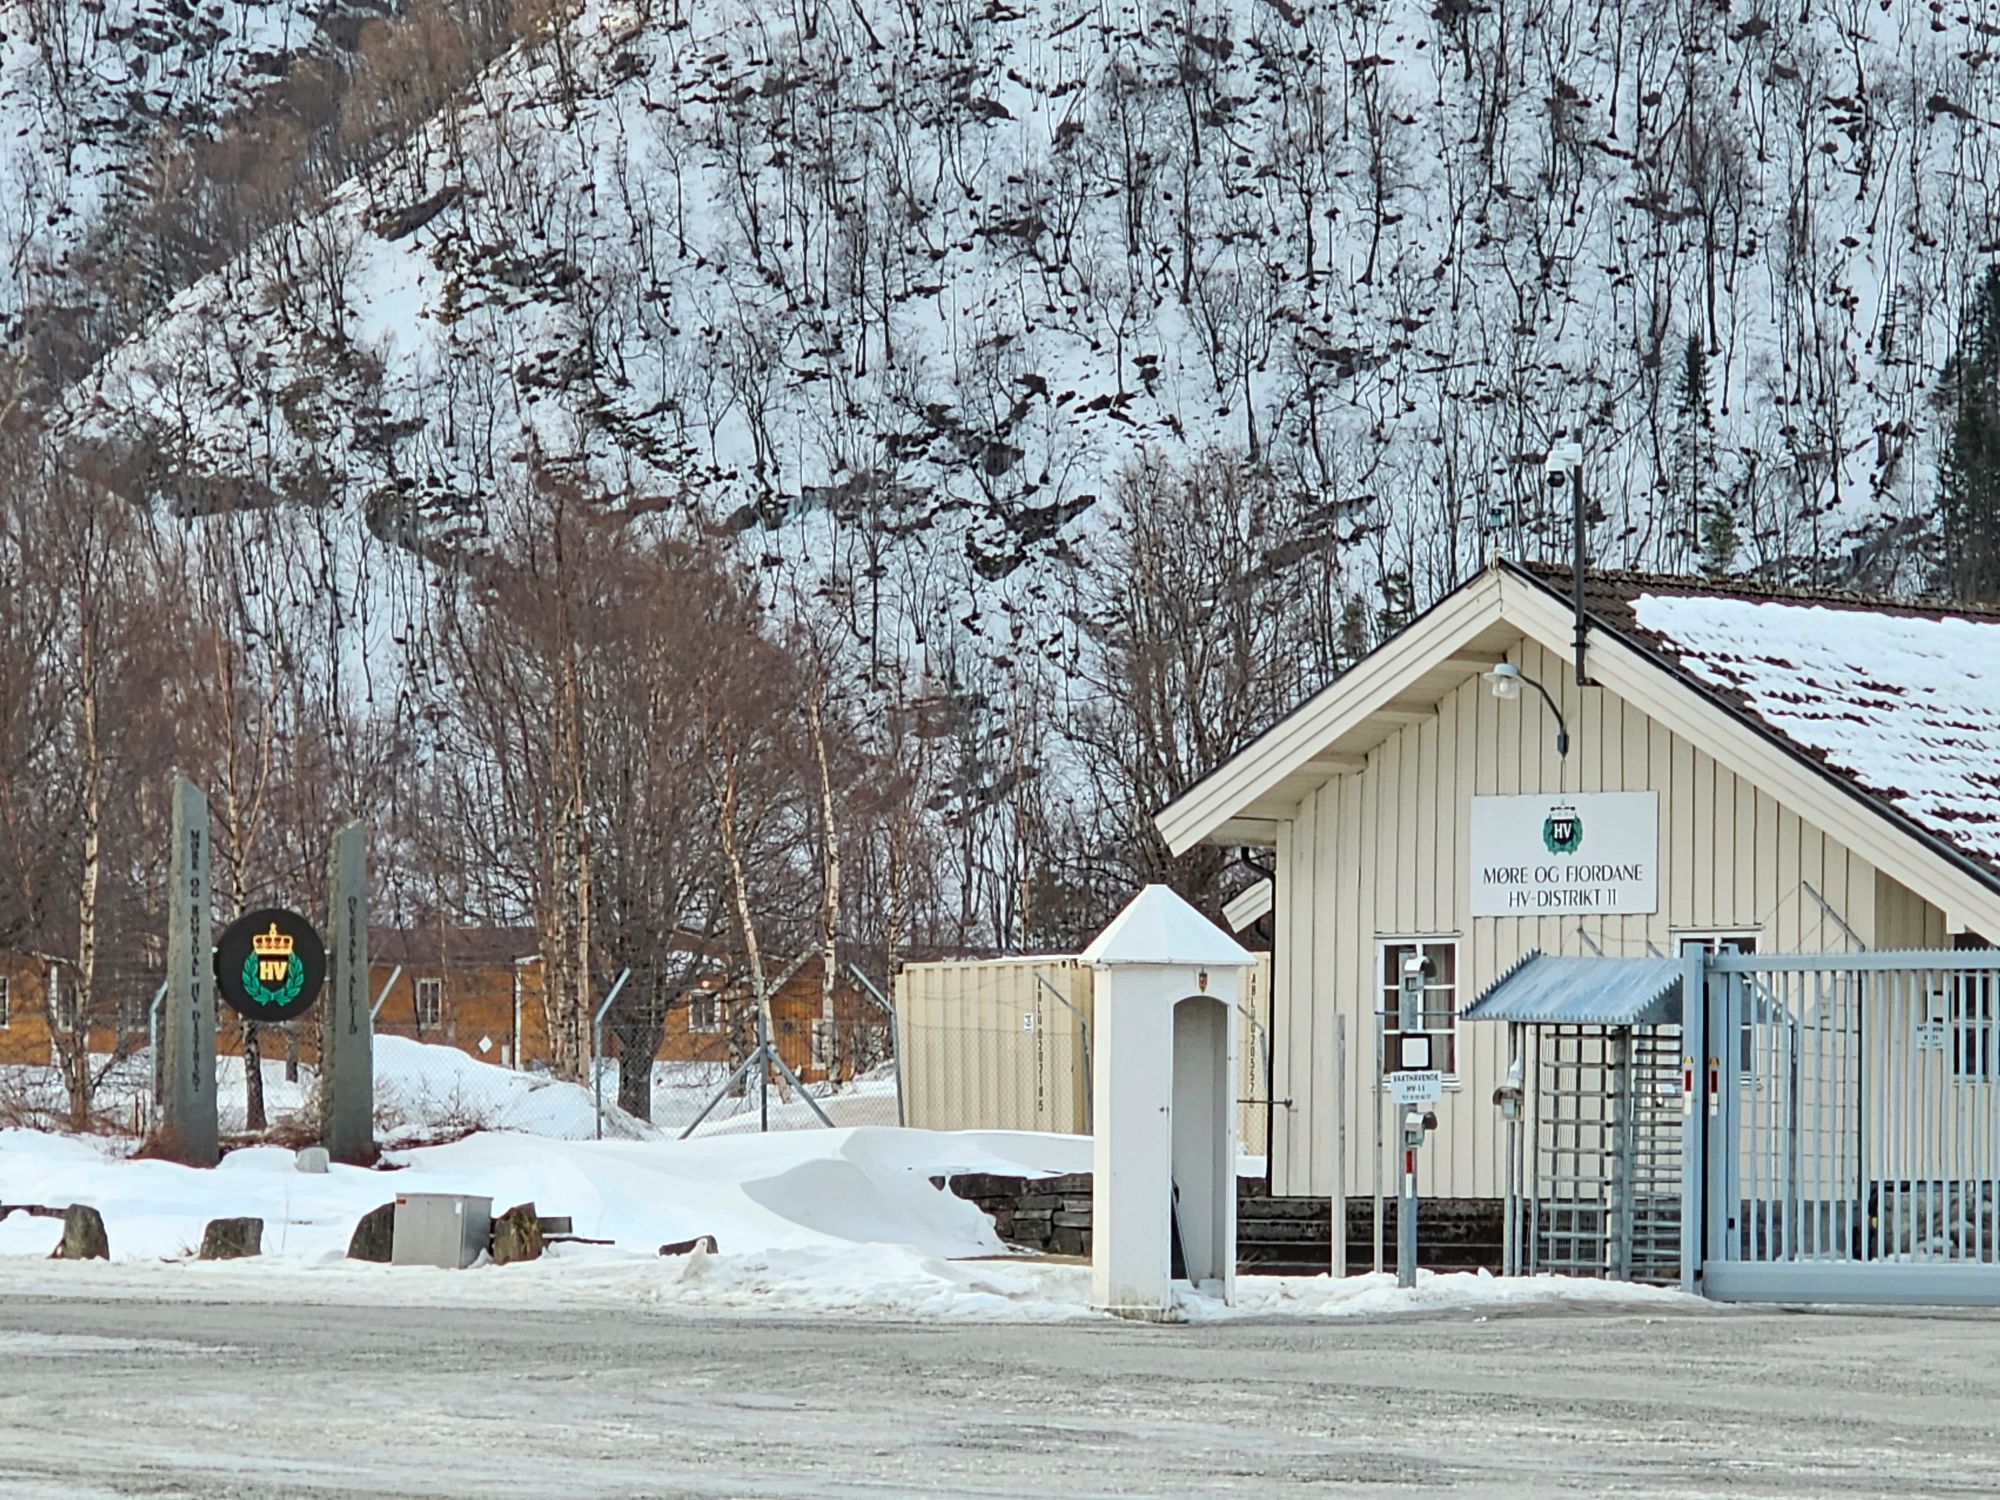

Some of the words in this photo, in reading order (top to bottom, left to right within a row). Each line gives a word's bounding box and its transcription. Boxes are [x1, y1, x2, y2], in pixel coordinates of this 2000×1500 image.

[1553, 823, 1572, 839] HV
[1483, 866, 1528, 885] MØRE
[1534, 866, 1560, 883] OG
[1566, 864, 1643, 883] FJORDANE
[190, 877, 200, 898] OG
[1509, 888, 1602, 908] HV-DISTRIKT
[259, 961, 287, 981] HV
